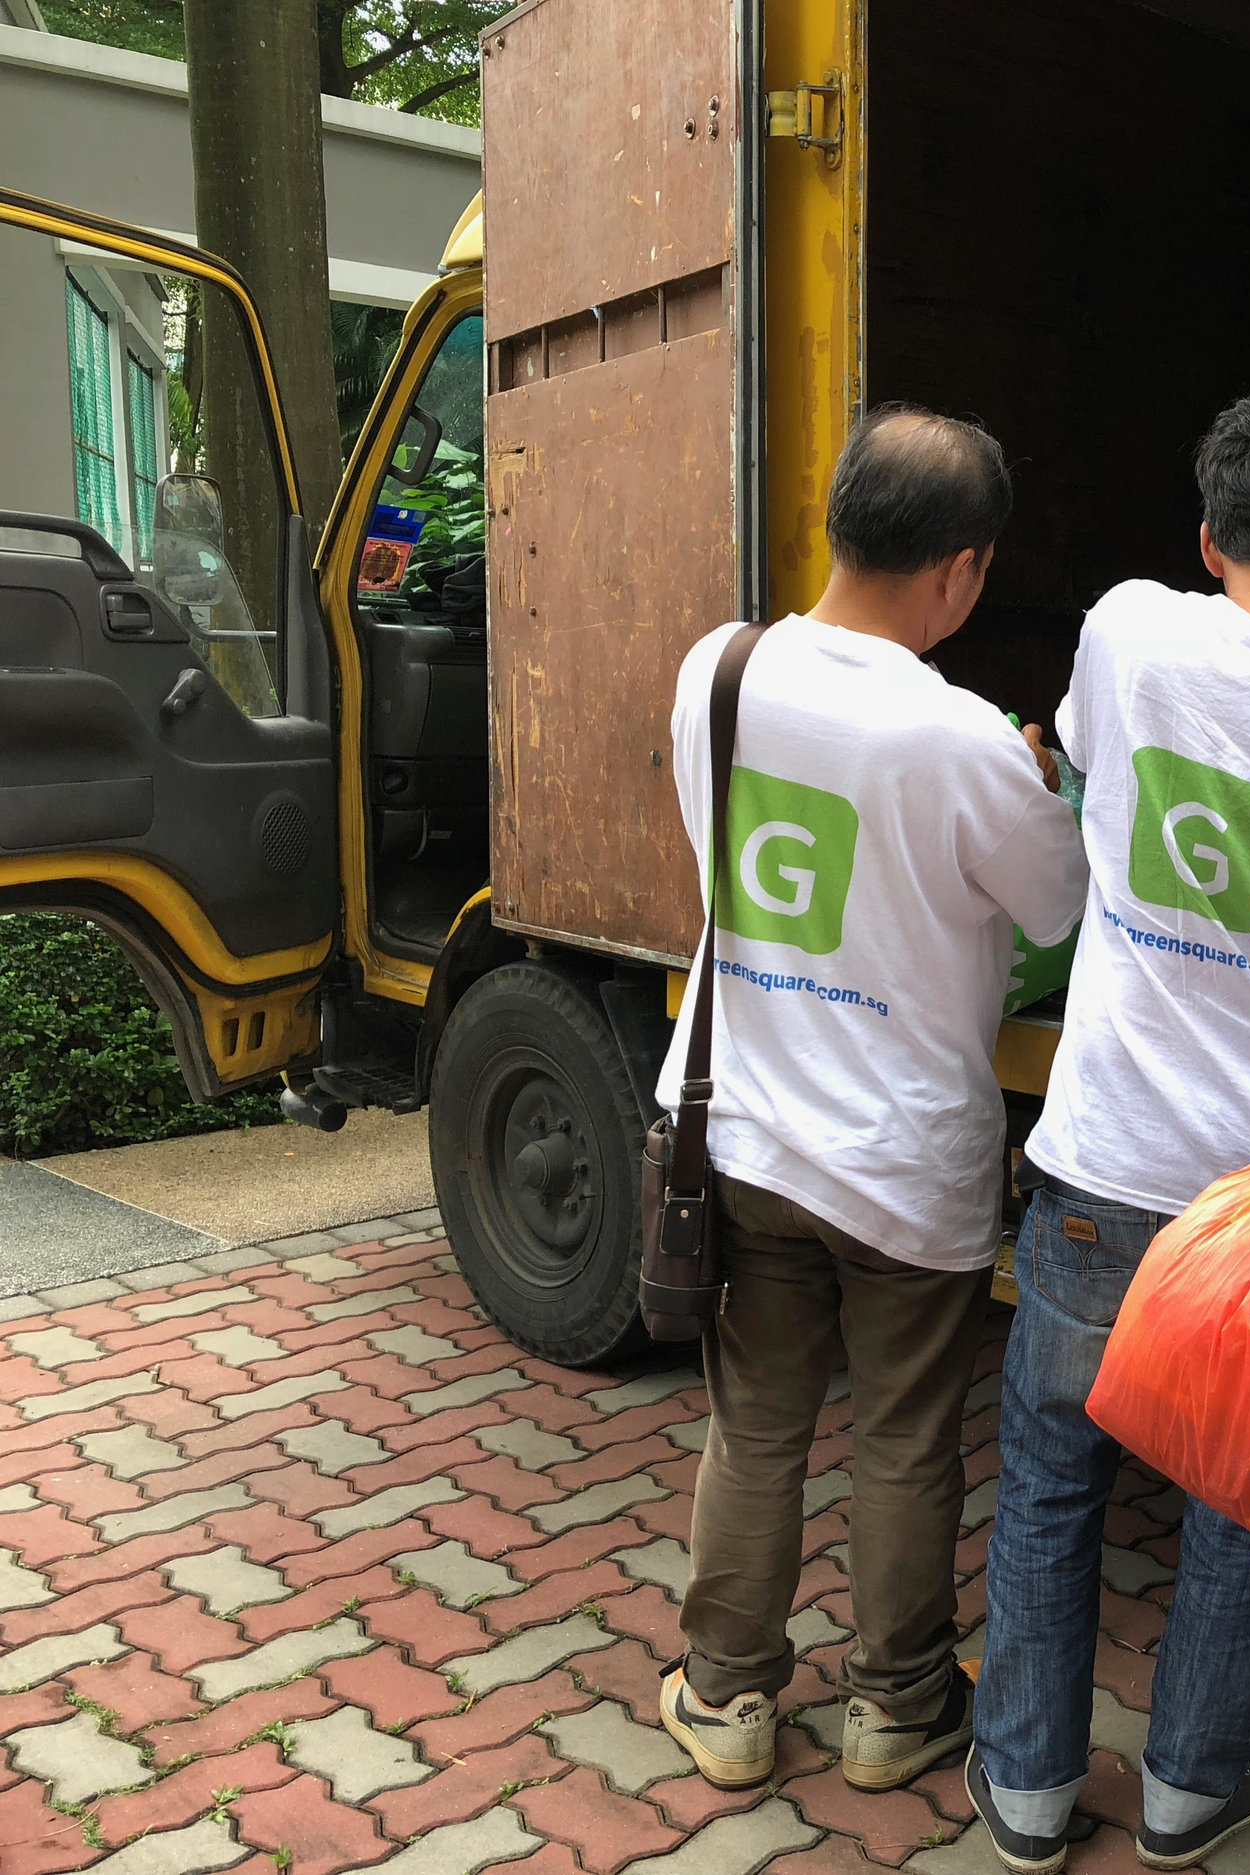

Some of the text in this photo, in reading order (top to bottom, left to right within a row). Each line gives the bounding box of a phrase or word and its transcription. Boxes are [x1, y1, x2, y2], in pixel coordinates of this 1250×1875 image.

[740, 821, 816, 917] G
[1162, 802, 1229, 896] G
[740, 1715, 760, 1724] AIR
